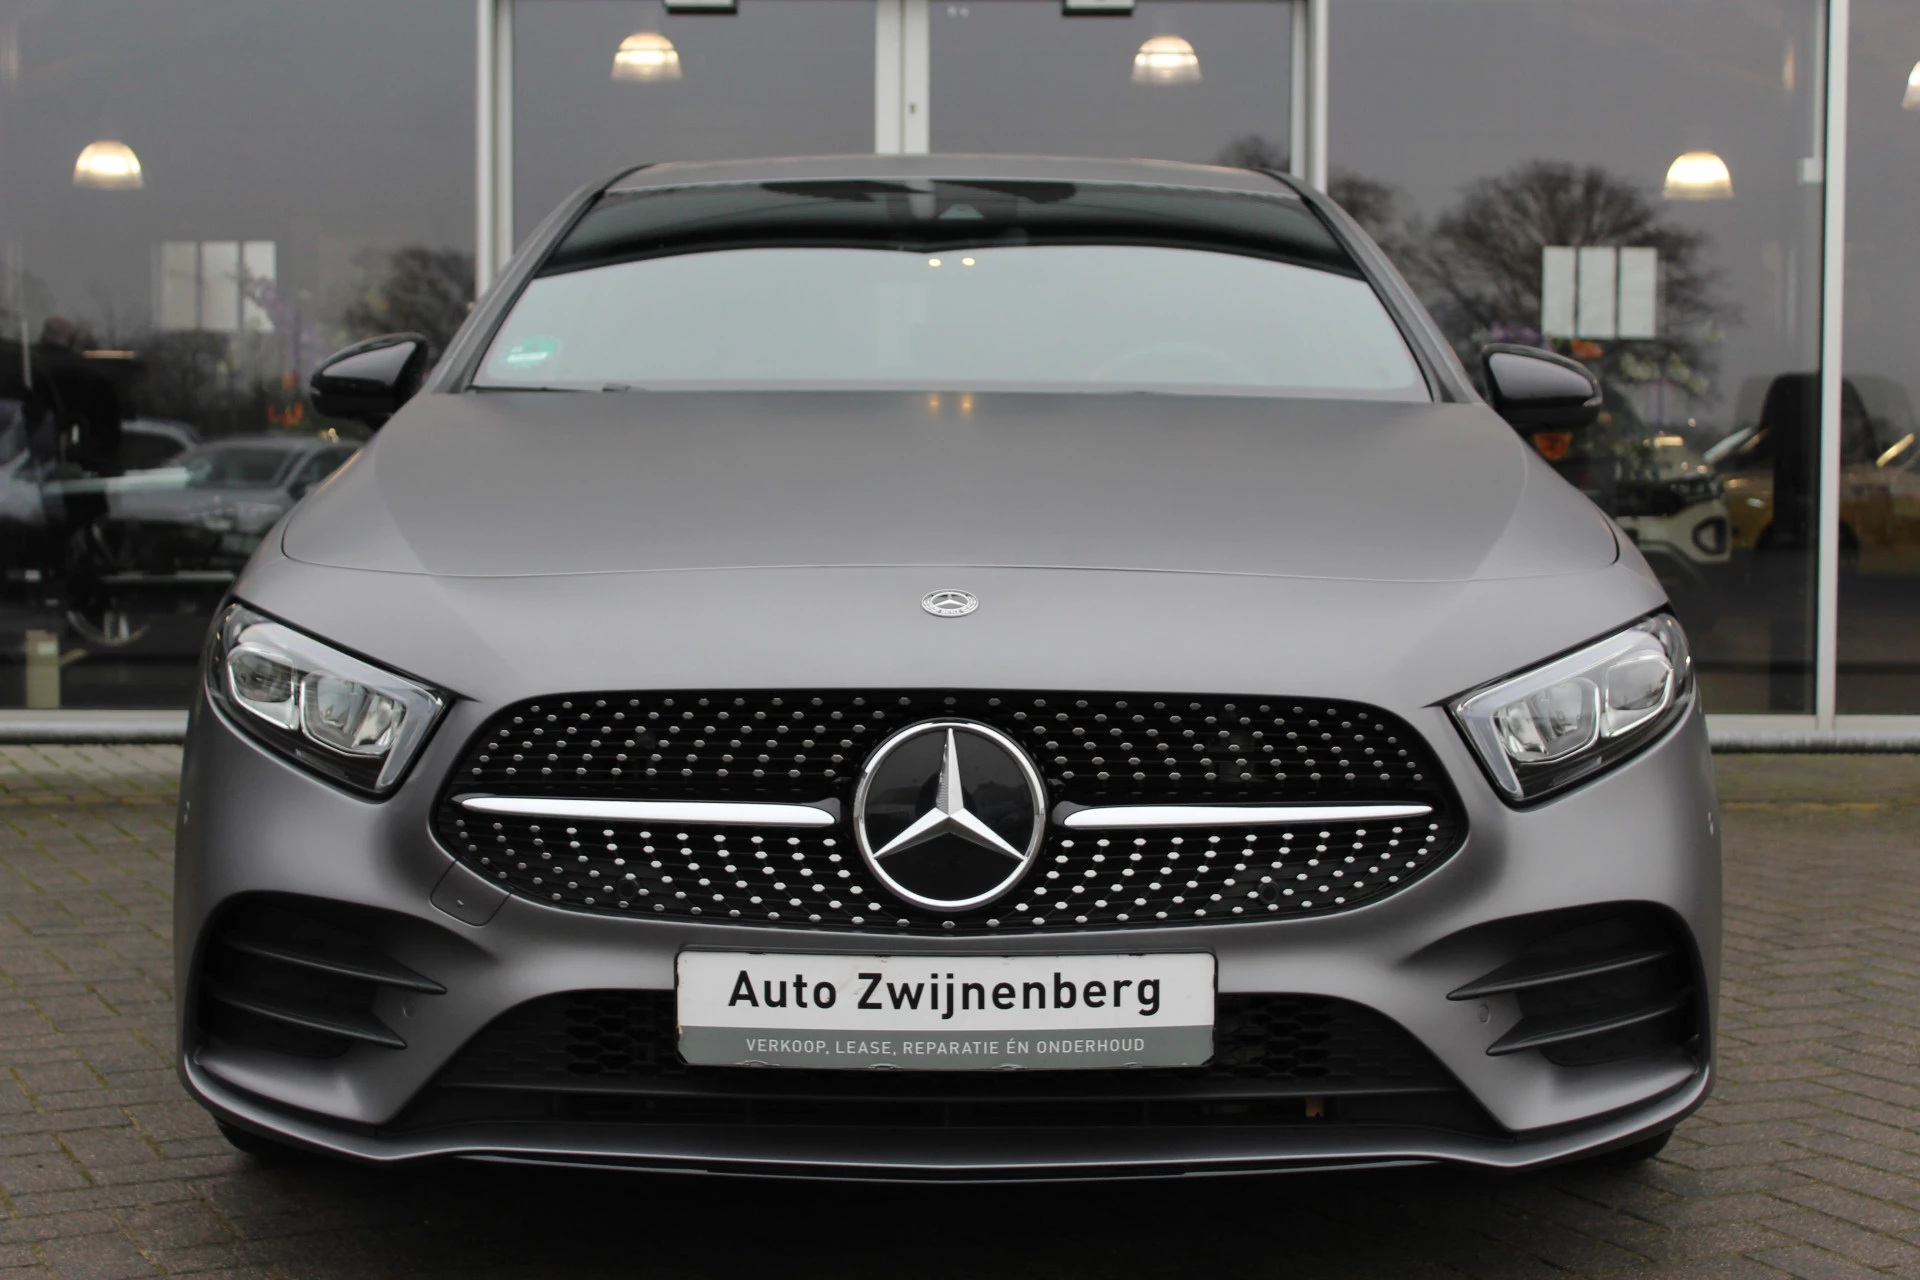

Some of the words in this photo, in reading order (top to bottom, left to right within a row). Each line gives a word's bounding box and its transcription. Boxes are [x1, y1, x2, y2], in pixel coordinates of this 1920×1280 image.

[728, 970, 837, 1008] Auto
[857, 972, 1161, 1019] Zwijnenberg
[746, 1038, 830, 1055] VERKOOP,
[835, 1040, 898, 1056] LEASE,
[903, 1041, 999, 1055] REPARATIE
[1006, 1037, 1029, 1054] ÉN
[1036, 1038, 1145, 1054] ONDERHOUD
